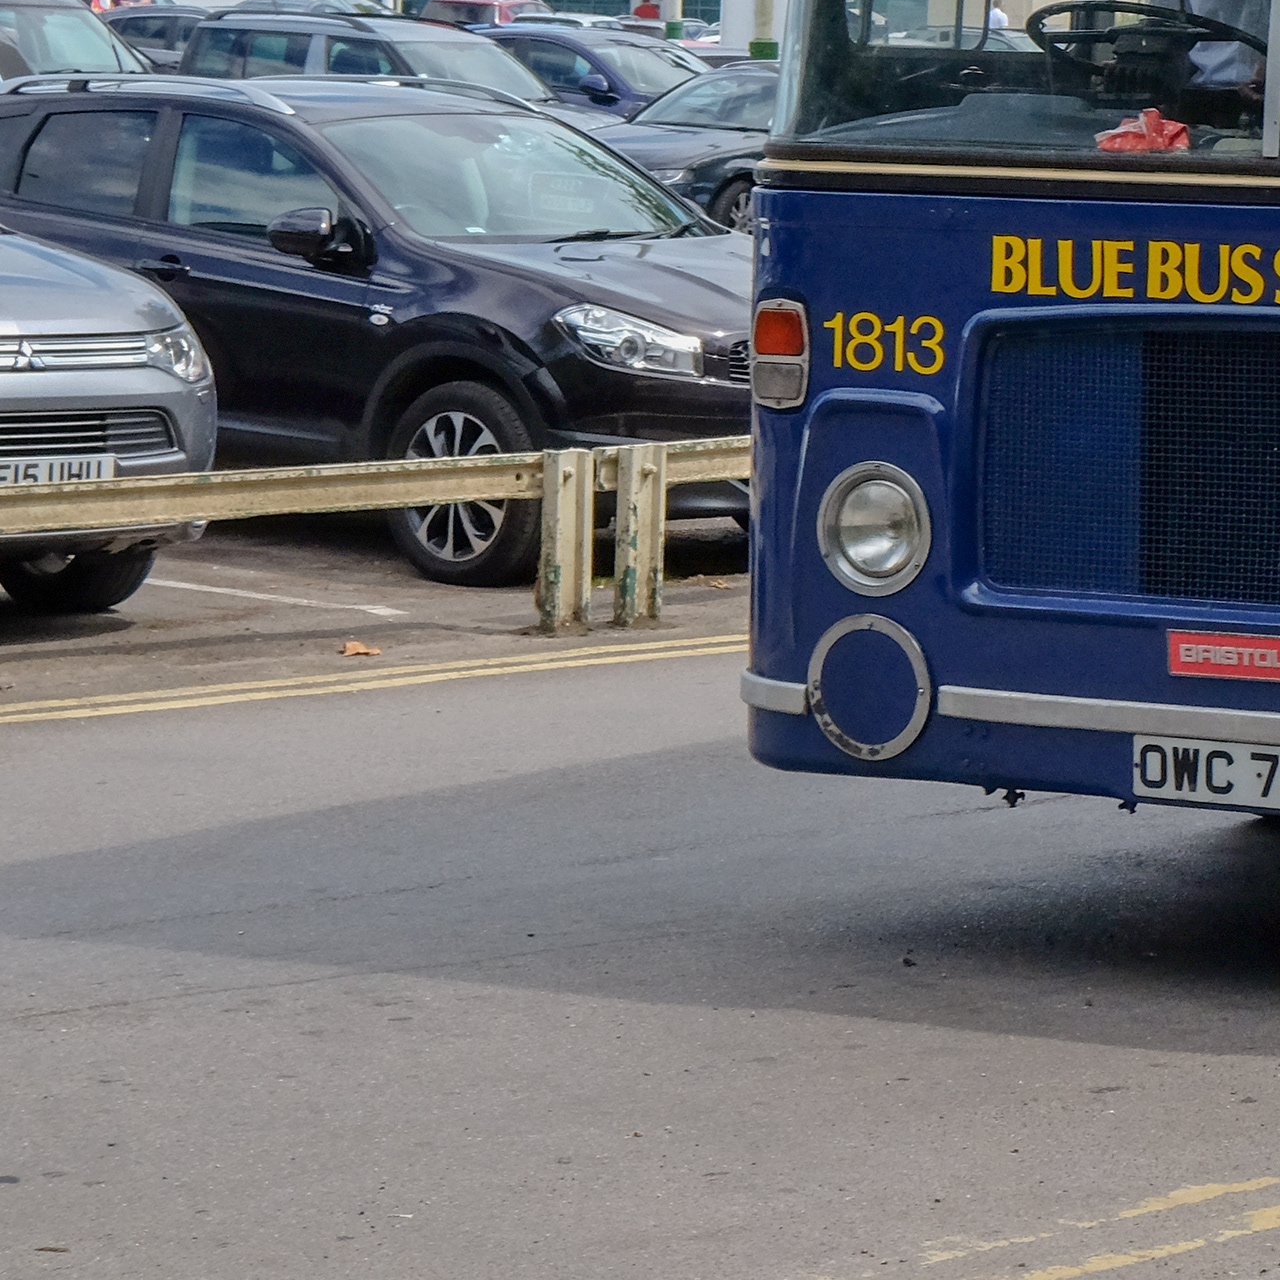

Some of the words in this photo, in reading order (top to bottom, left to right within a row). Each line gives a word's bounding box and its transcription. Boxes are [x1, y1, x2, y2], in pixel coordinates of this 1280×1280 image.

[990, 235, 1135, 299] BLUE
[1146, 240, 1265, 304] BUS
[823, 311, 946, 375] 1813
[1139, 743, 1235, 795] OWC
